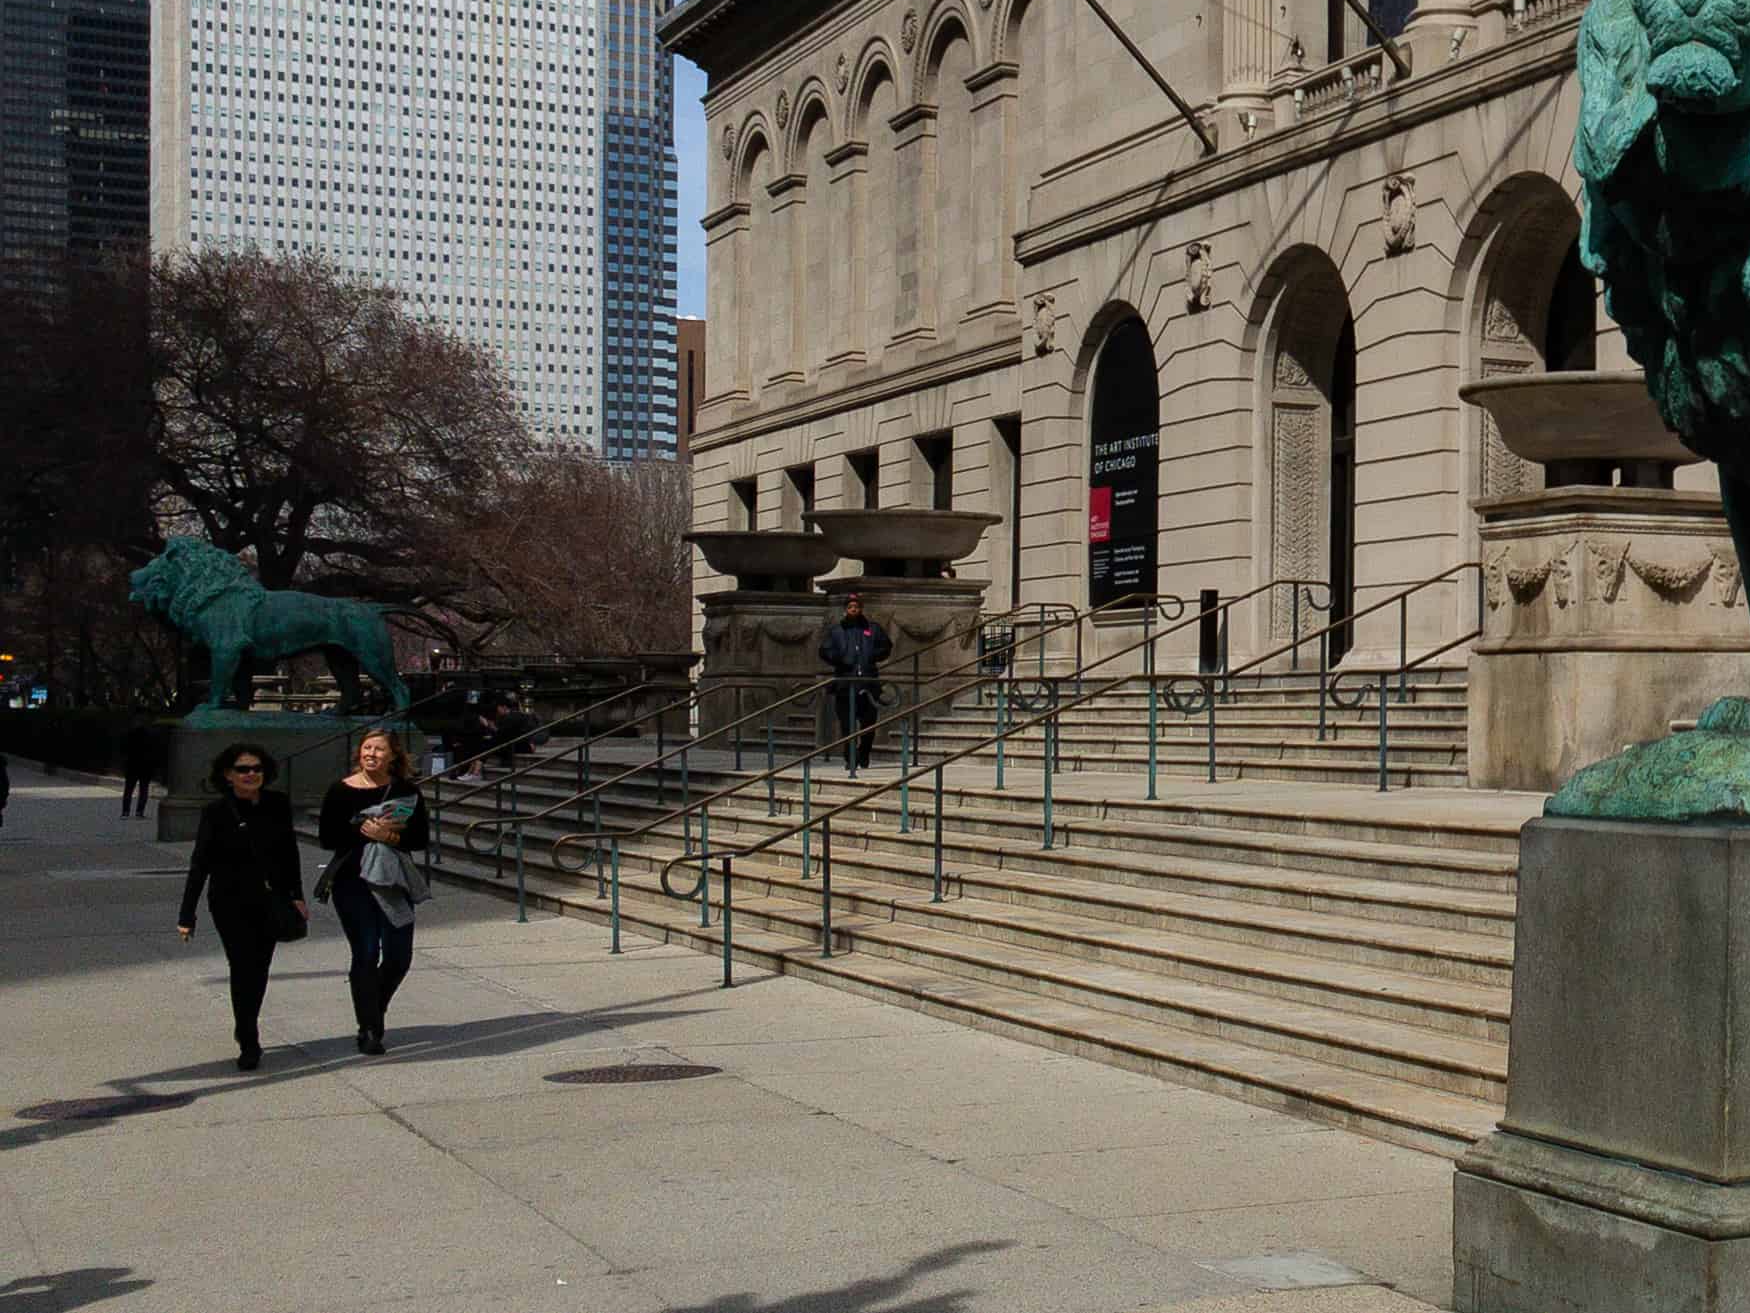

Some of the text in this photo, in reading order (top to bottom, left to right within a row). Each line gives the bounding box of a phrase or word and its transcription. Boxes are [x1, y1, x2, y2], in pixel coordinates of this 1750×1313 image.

[1095, 433, 1159, 457] THE ART INSTITUTE
[1095, 455, 1136, 475] OF CHICAGO
